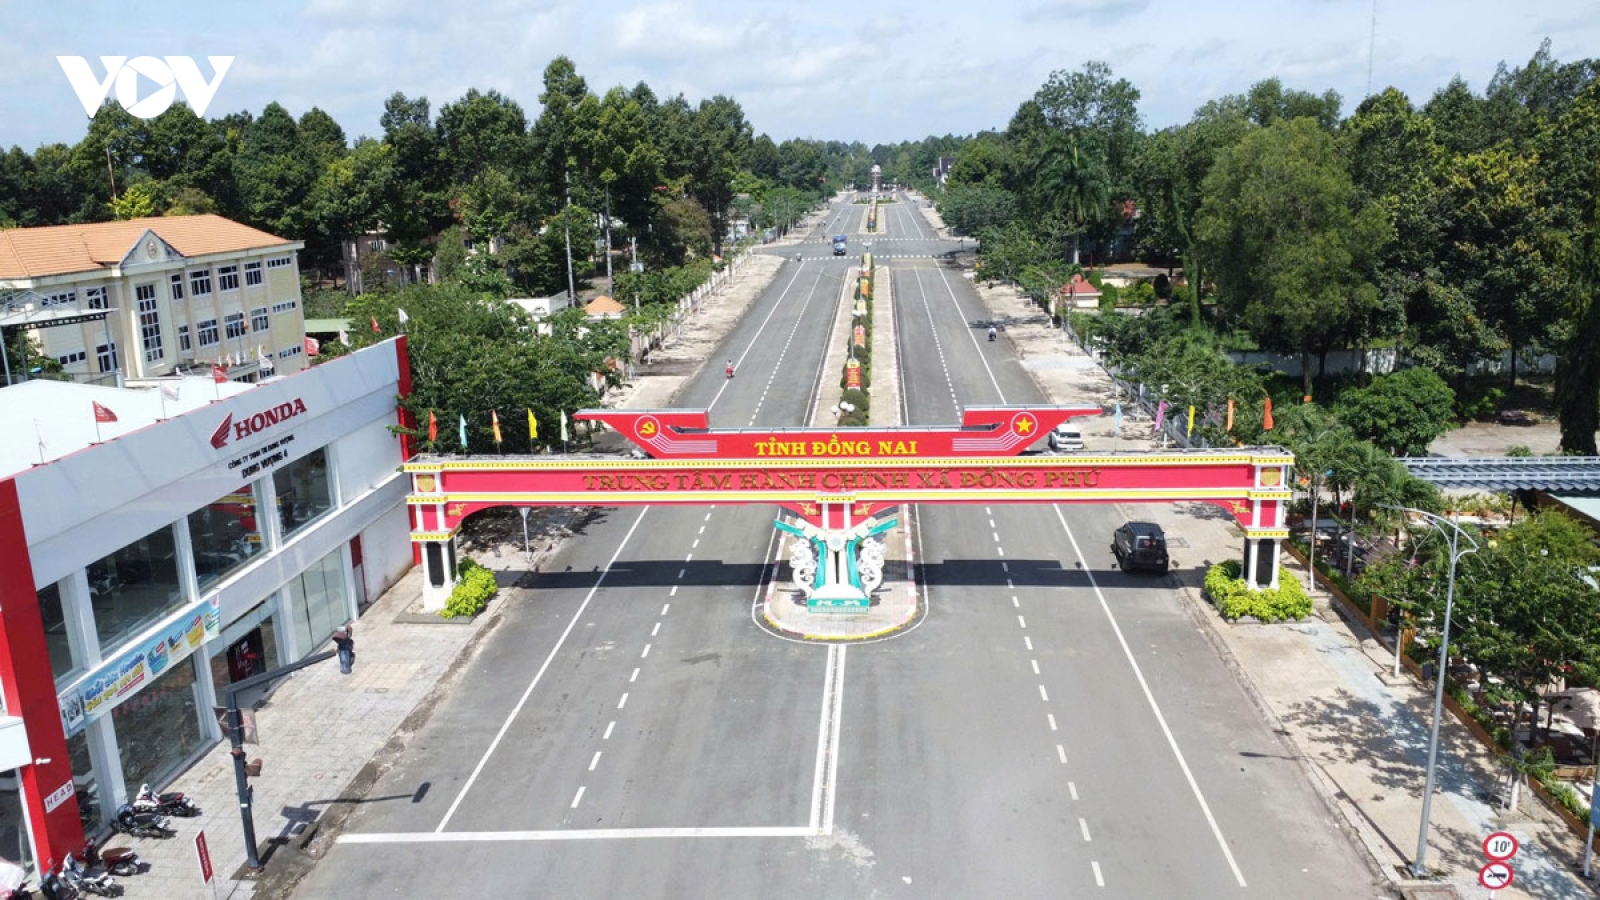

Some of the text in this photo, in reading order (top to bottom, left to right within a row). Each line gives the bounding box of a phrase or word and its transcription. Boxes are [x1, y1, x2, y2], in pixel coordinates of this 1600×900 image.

[234, 397, 307, 440] HONDA
[754, 434, 917, 456] TỈNH ĐỒNG NAI
[582, 466, 1101, 490] TRUNG TÂM HÀNH CHÍNH XÃ ĐỒNG PHÚ
[46, 783, 73, 807] HEAD
